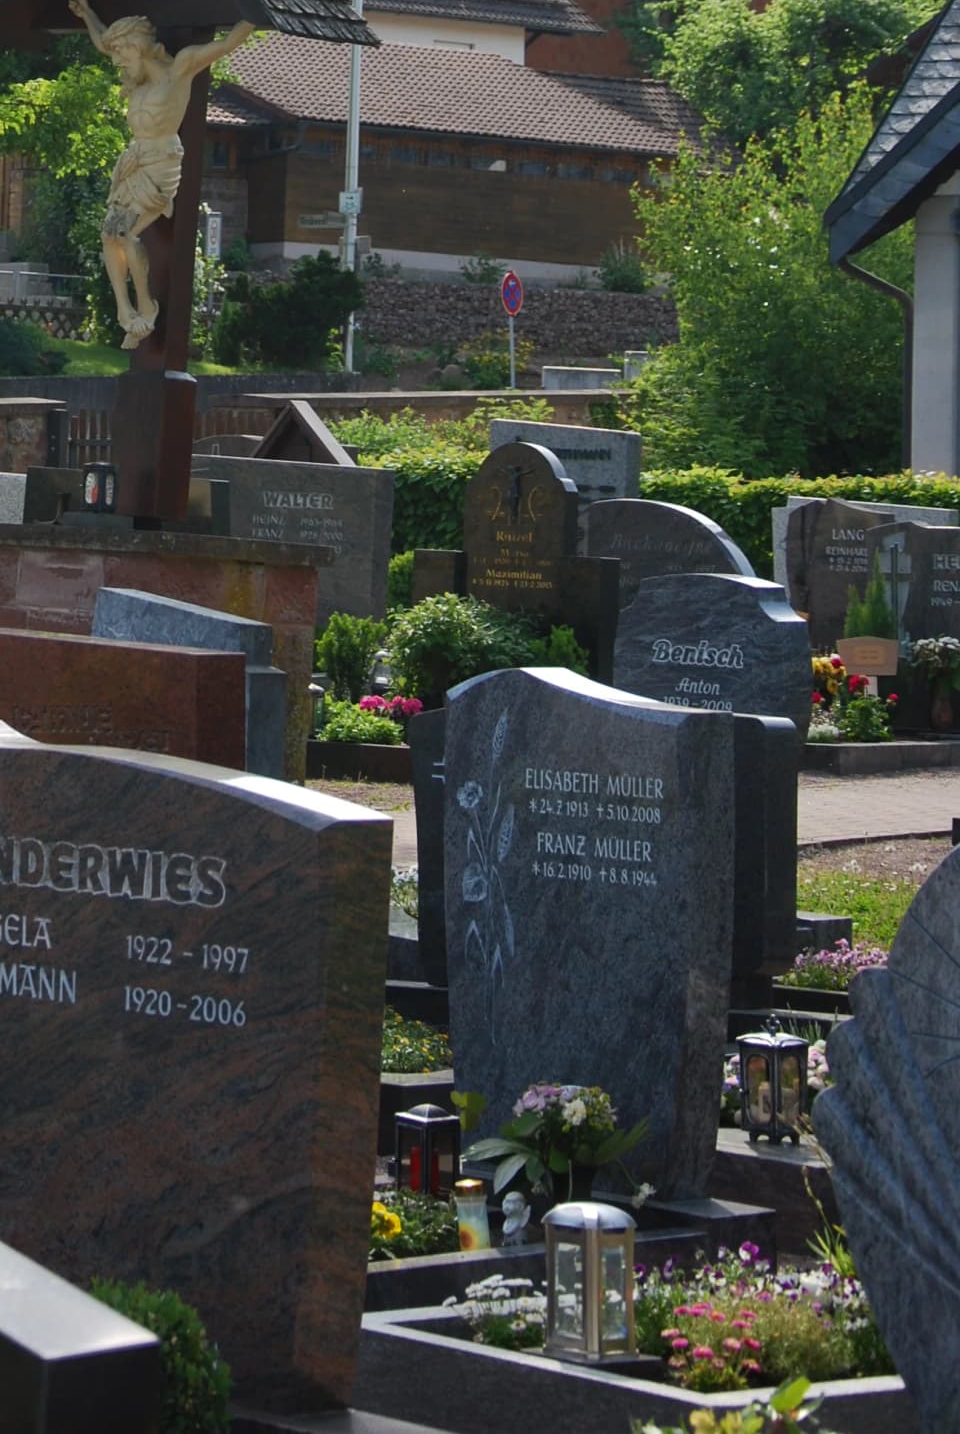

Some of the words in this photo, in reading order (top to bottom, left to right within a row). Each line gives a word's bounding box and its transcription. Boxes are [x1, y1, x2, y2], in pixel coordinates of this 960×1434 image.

[263, 490, 335, 510] WALTER
[831, 528, 865, 541] LANG
[932, 553, 960, 570] HE
[933, 580, 960, 592] REN
[652, 638, 744, 669] Benisch
[675, 677, 721, 695] Anton
[525, 768, 599, 794] ELISABETH
[606, 773, 664, 799] MÜLLER
[537, 831, 587, 857] FRANZ
[593, 837, 652, 862] MÜLLER
[126, 934, 173, 966] 1922
[202, 943, 249, 974] 1997
[124, 985, 172, 1017] 1920
[189, 994, 247, 1027] 2006
